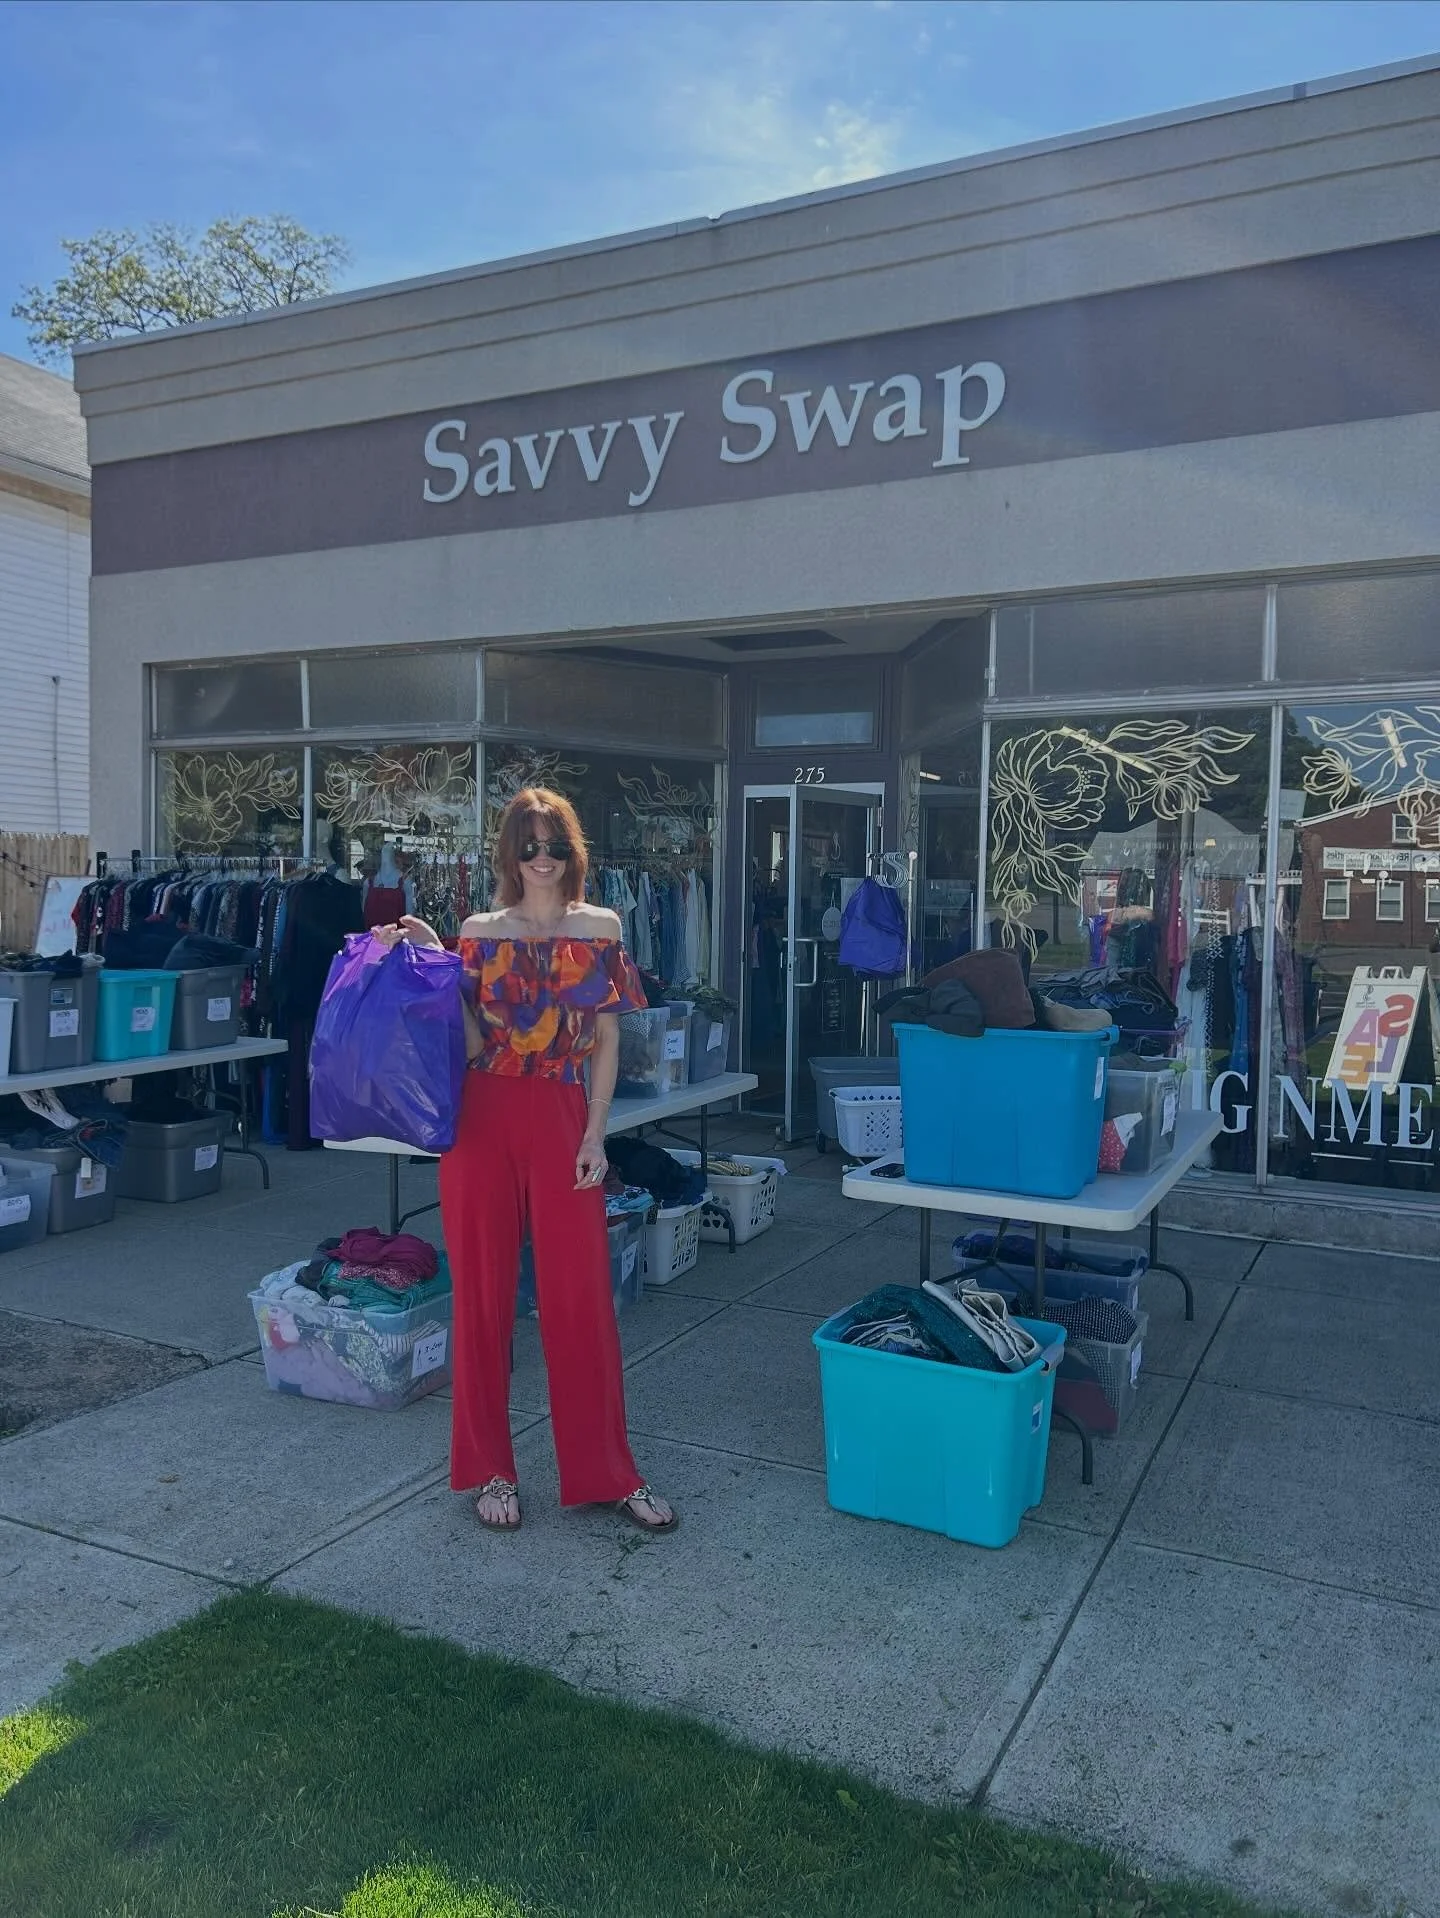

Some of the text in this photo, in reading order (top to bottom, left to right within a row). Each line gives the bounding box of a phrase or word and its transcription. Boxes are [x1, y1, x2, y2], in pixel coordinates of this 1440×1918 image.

[422, 360, 1007, 508] Savvy Swap
[794, 766, 825, 784] 275
